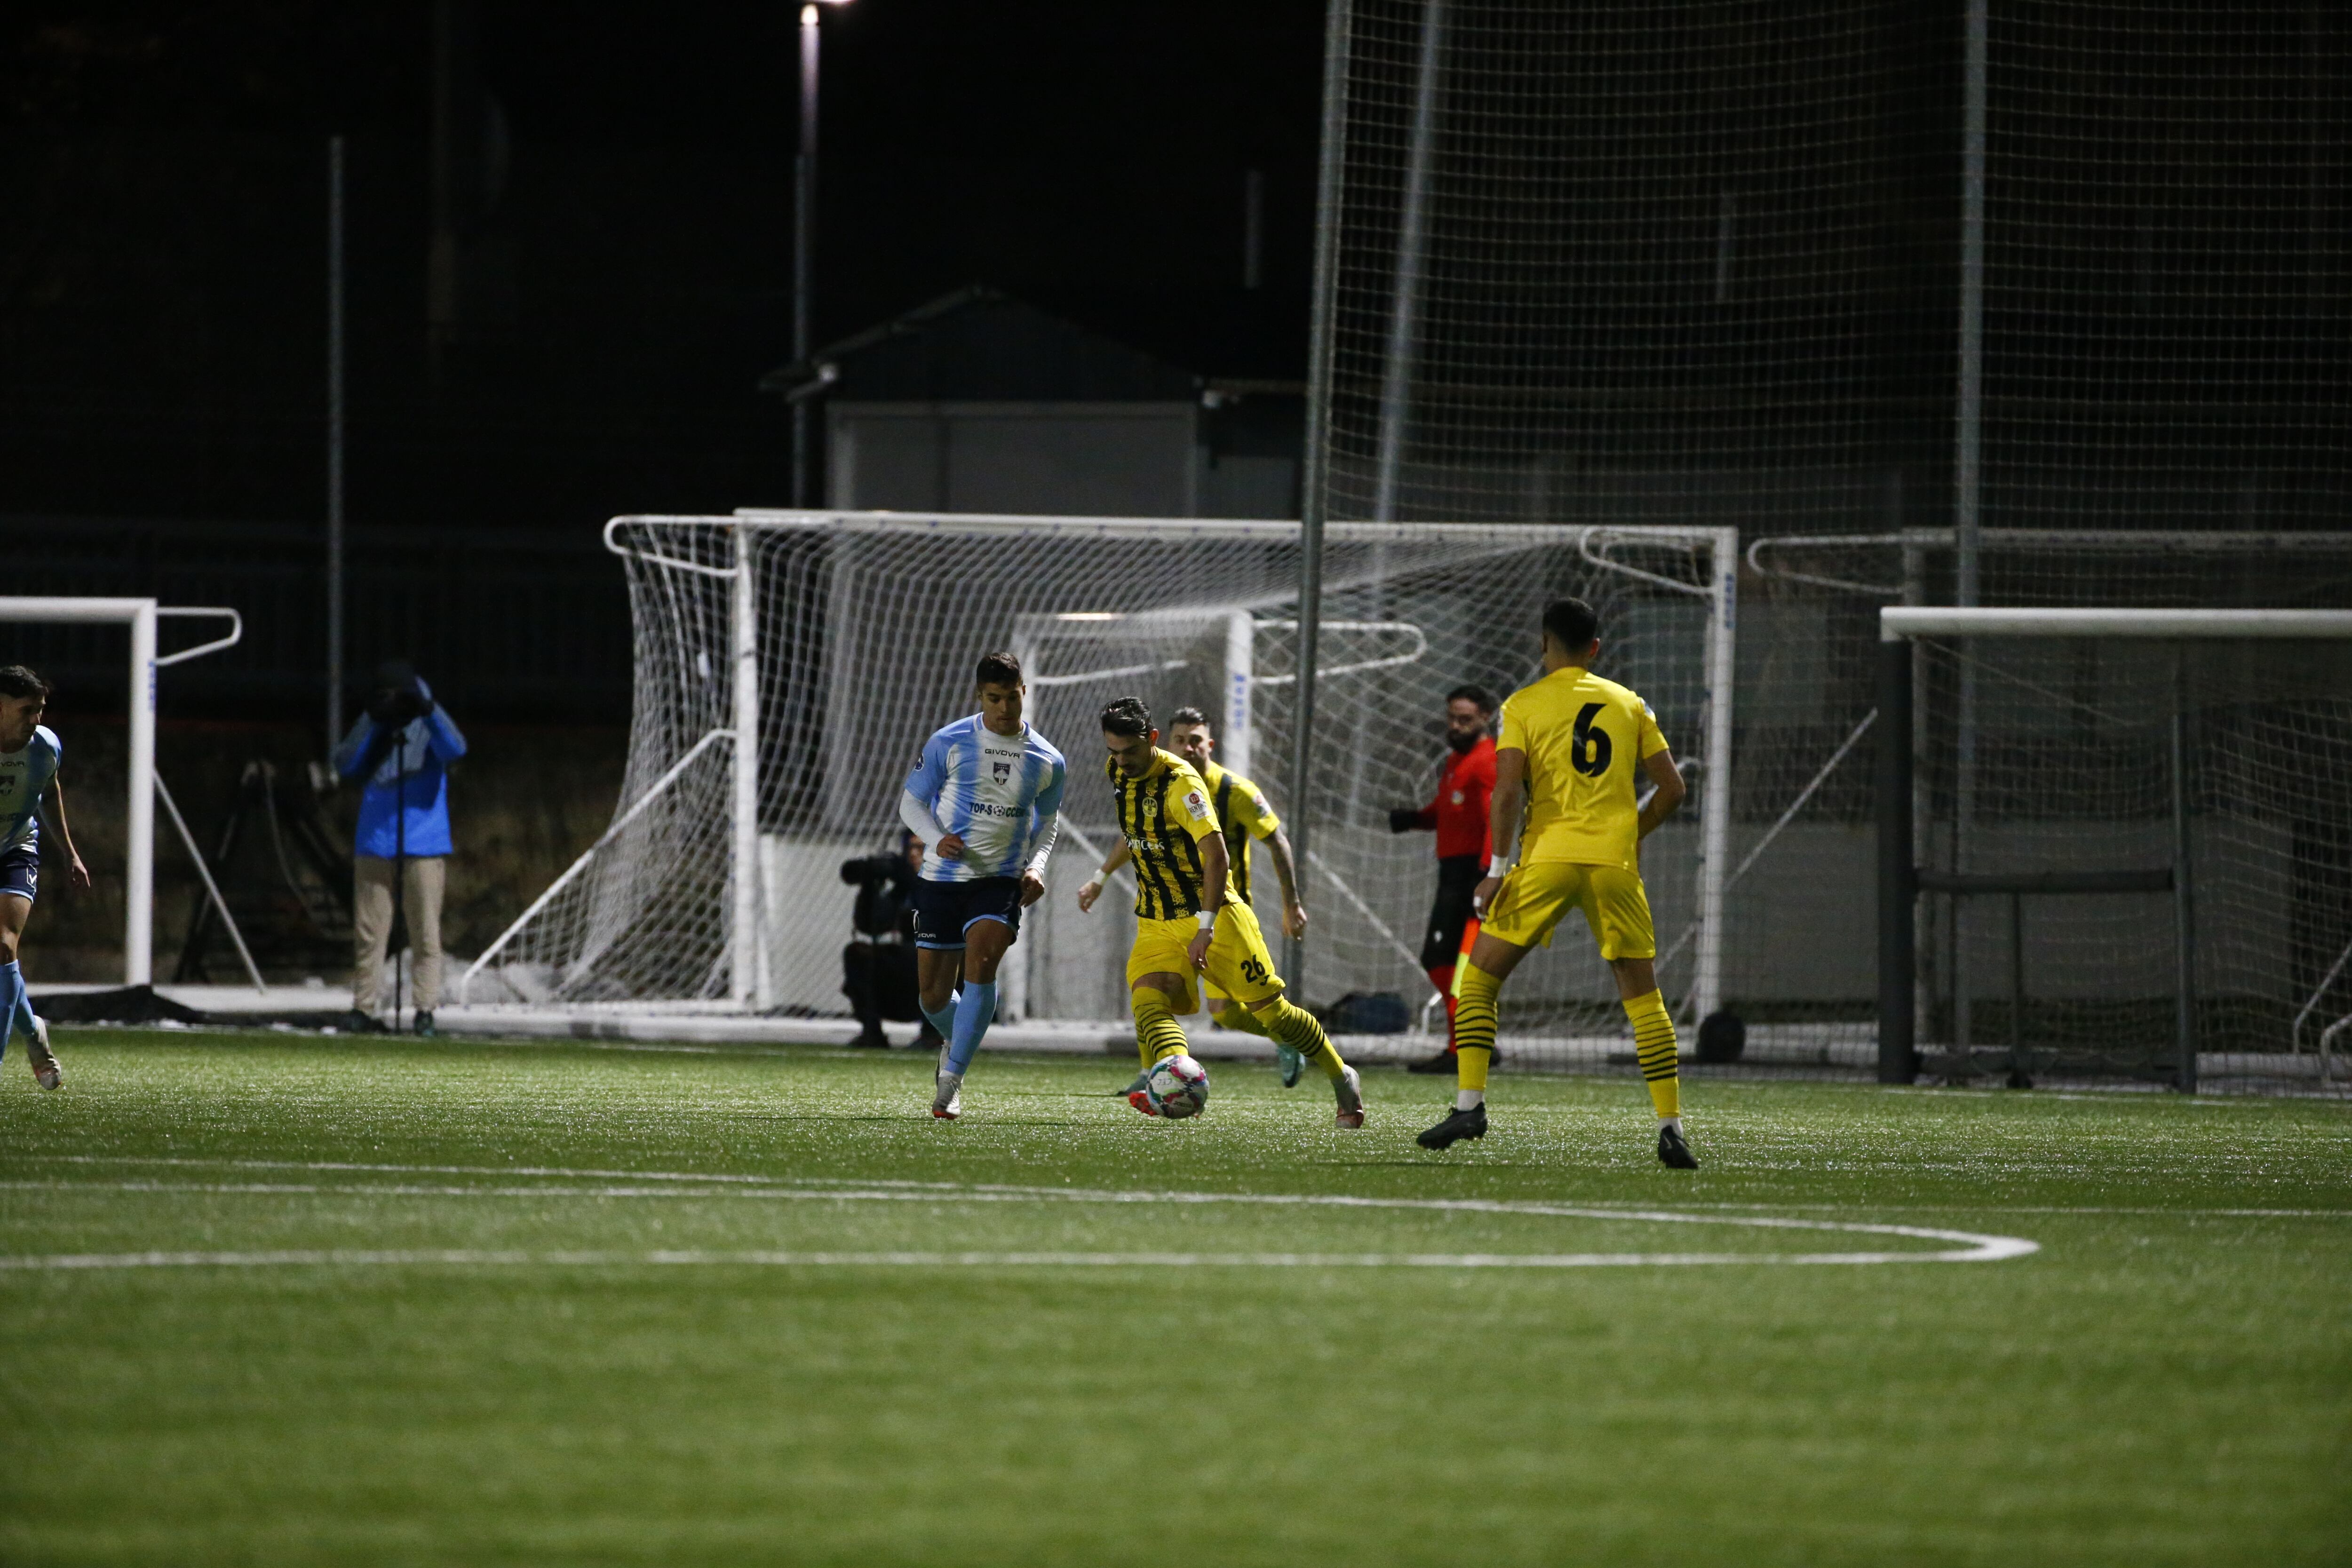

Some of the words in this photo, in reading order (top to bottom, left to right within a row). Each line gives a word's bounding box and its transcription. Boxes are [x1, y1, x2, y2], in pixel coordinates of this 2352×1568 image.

[985, 749, 1020, 759] GIVOVA
[1572, 703, 1612, 777] 6
[1240, 954, 1265, 984] 26
